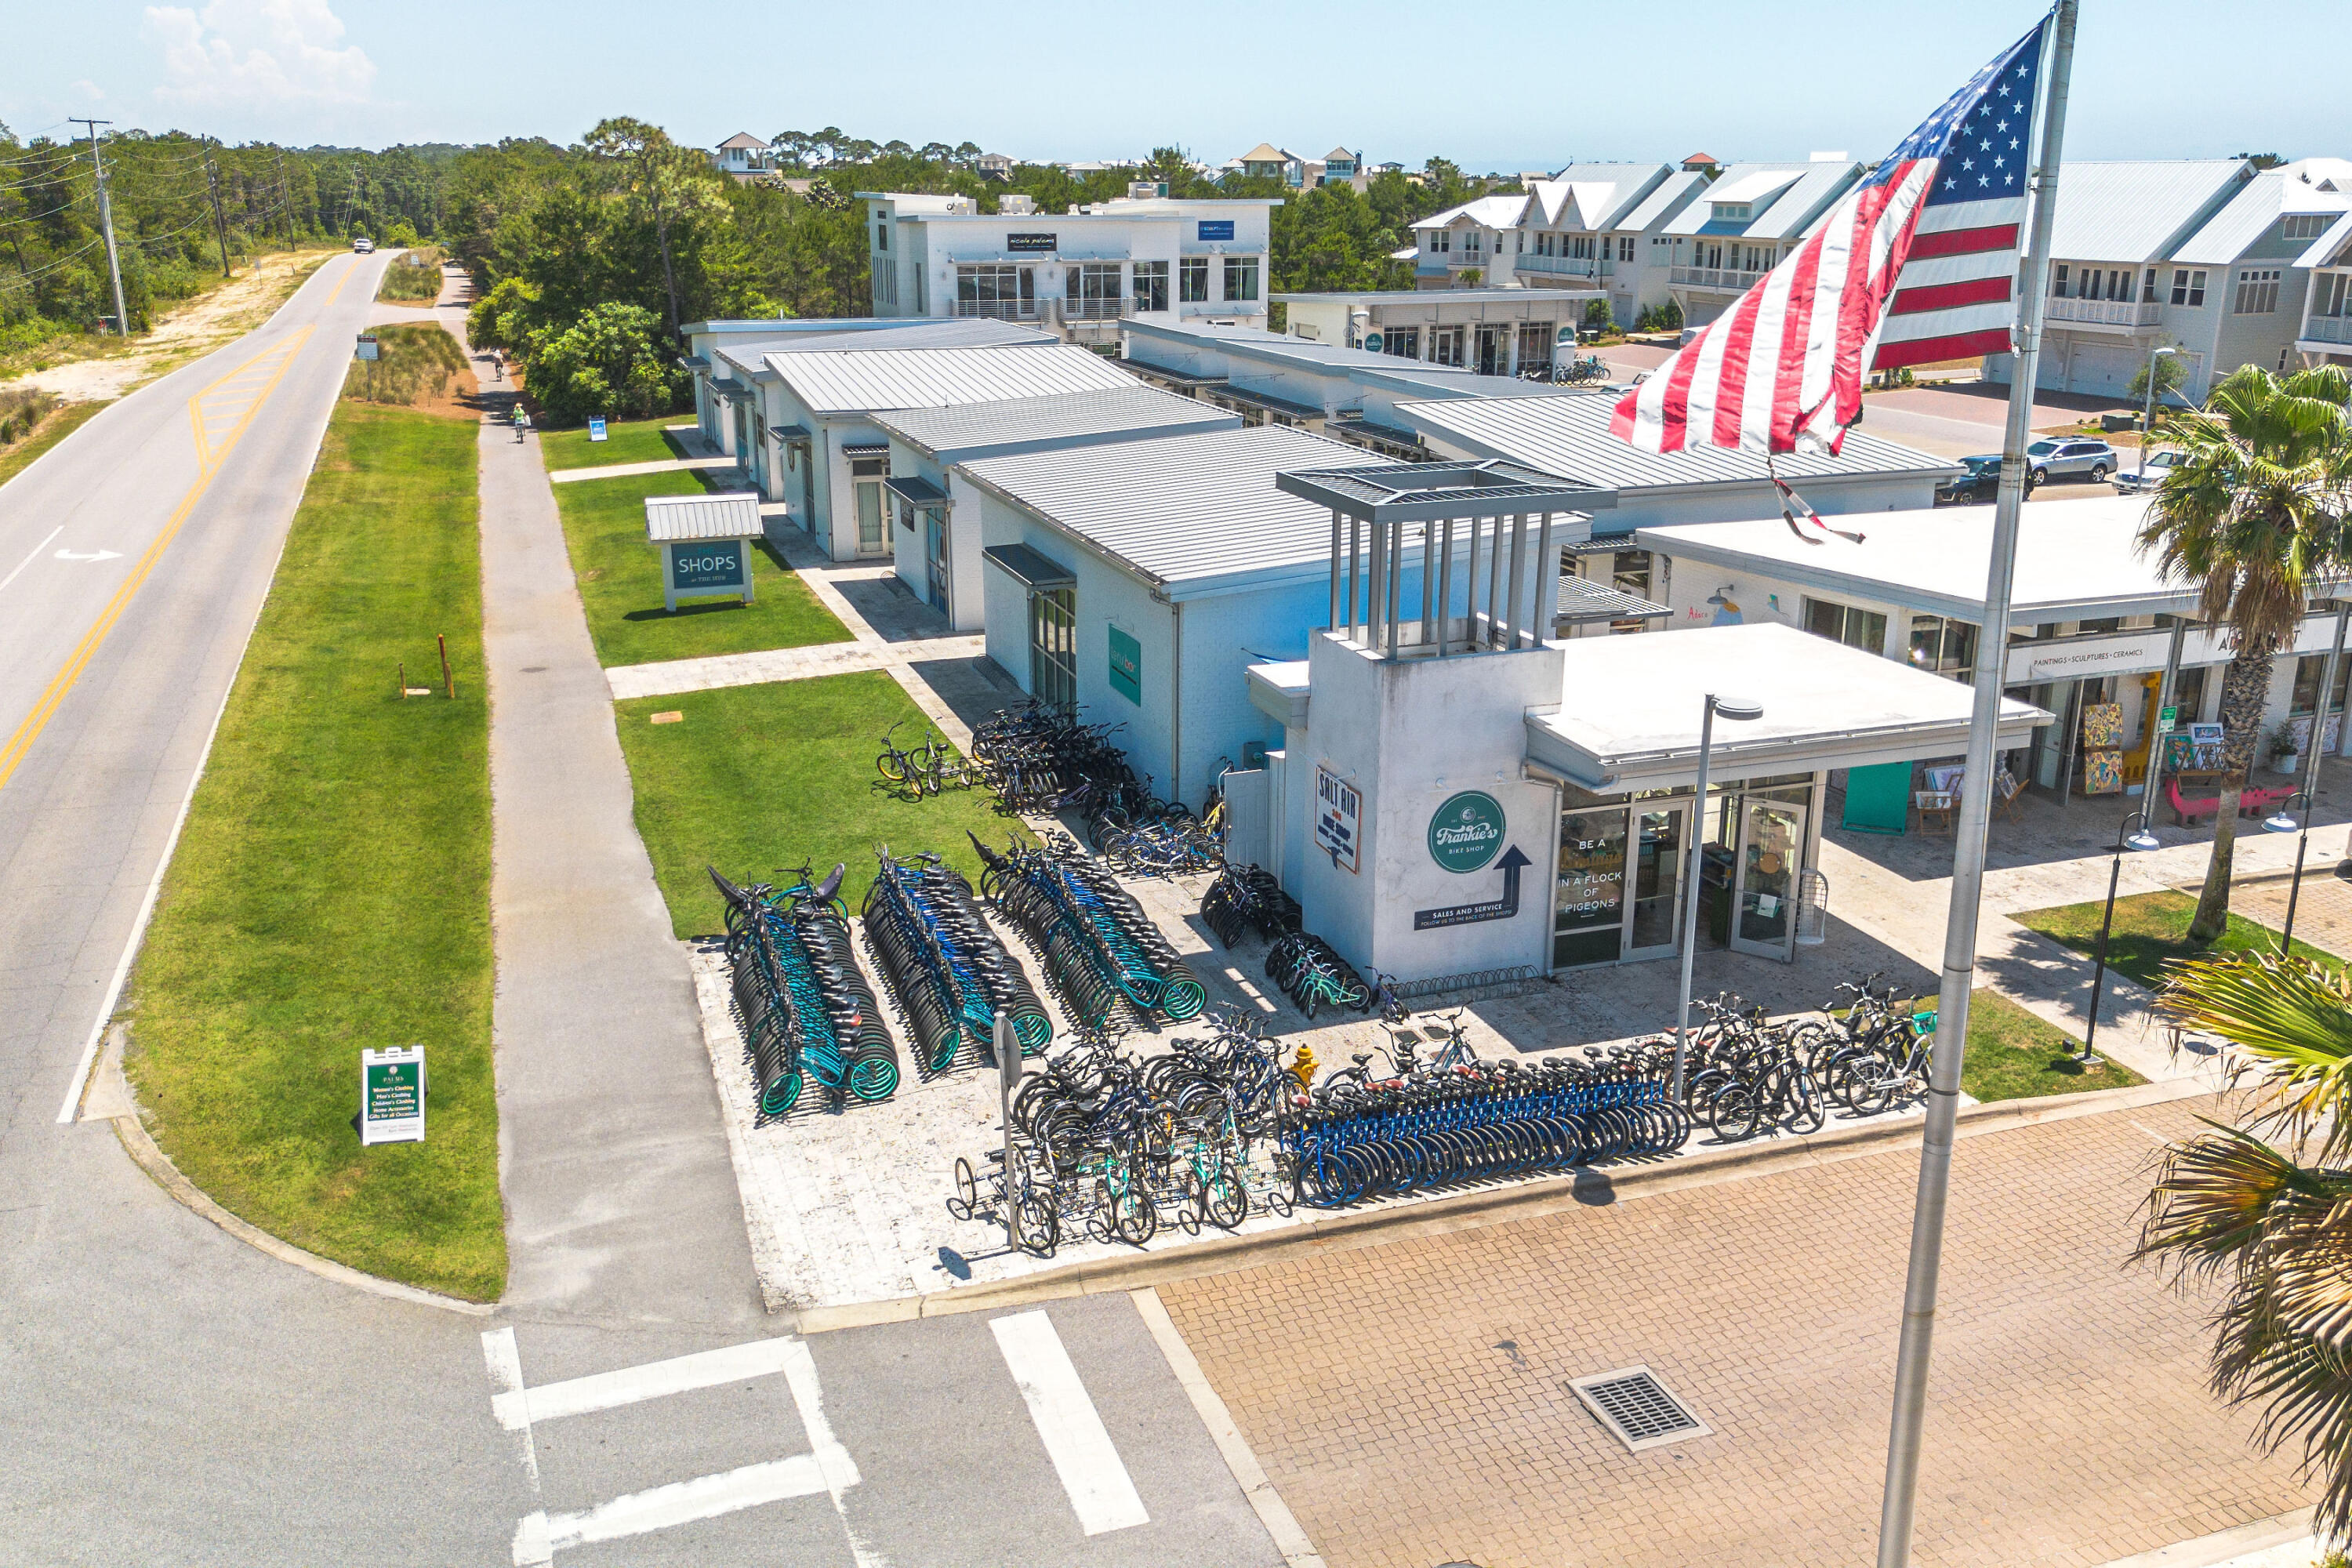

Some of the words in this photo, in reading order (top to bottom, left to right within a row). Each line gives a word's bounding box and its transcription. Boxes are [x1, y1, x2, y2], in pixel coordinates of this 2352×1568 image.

[678, 556, 736, 573] SHOPS
[2034, 656, 2067, 666] PAINTINGS
[2071, 652, 2109, 662] SCULPTURES
[2113, 648, 2143, 659] CERAMICS
[1319, 772, 1338, 808] SALT
[1341, 787, 1356, 819] AIR
[1436, 822, 1498, 846] Frankie's
[1465, 845, 1485, 854] SHOP
[1579, 840, 1594, 850] BE
[1598, 838, 1606, 848] A
[1558, 878, 1569, 887] IN
[1573, 877, 1581, 886] A
[1584, 871, 1622, 884] FLOCK
[1583, 887, 1599, 897] OF
[1475, 903, 1502, 913] SERVICE
[1565, 898, 1615, 913] PIGEONS
